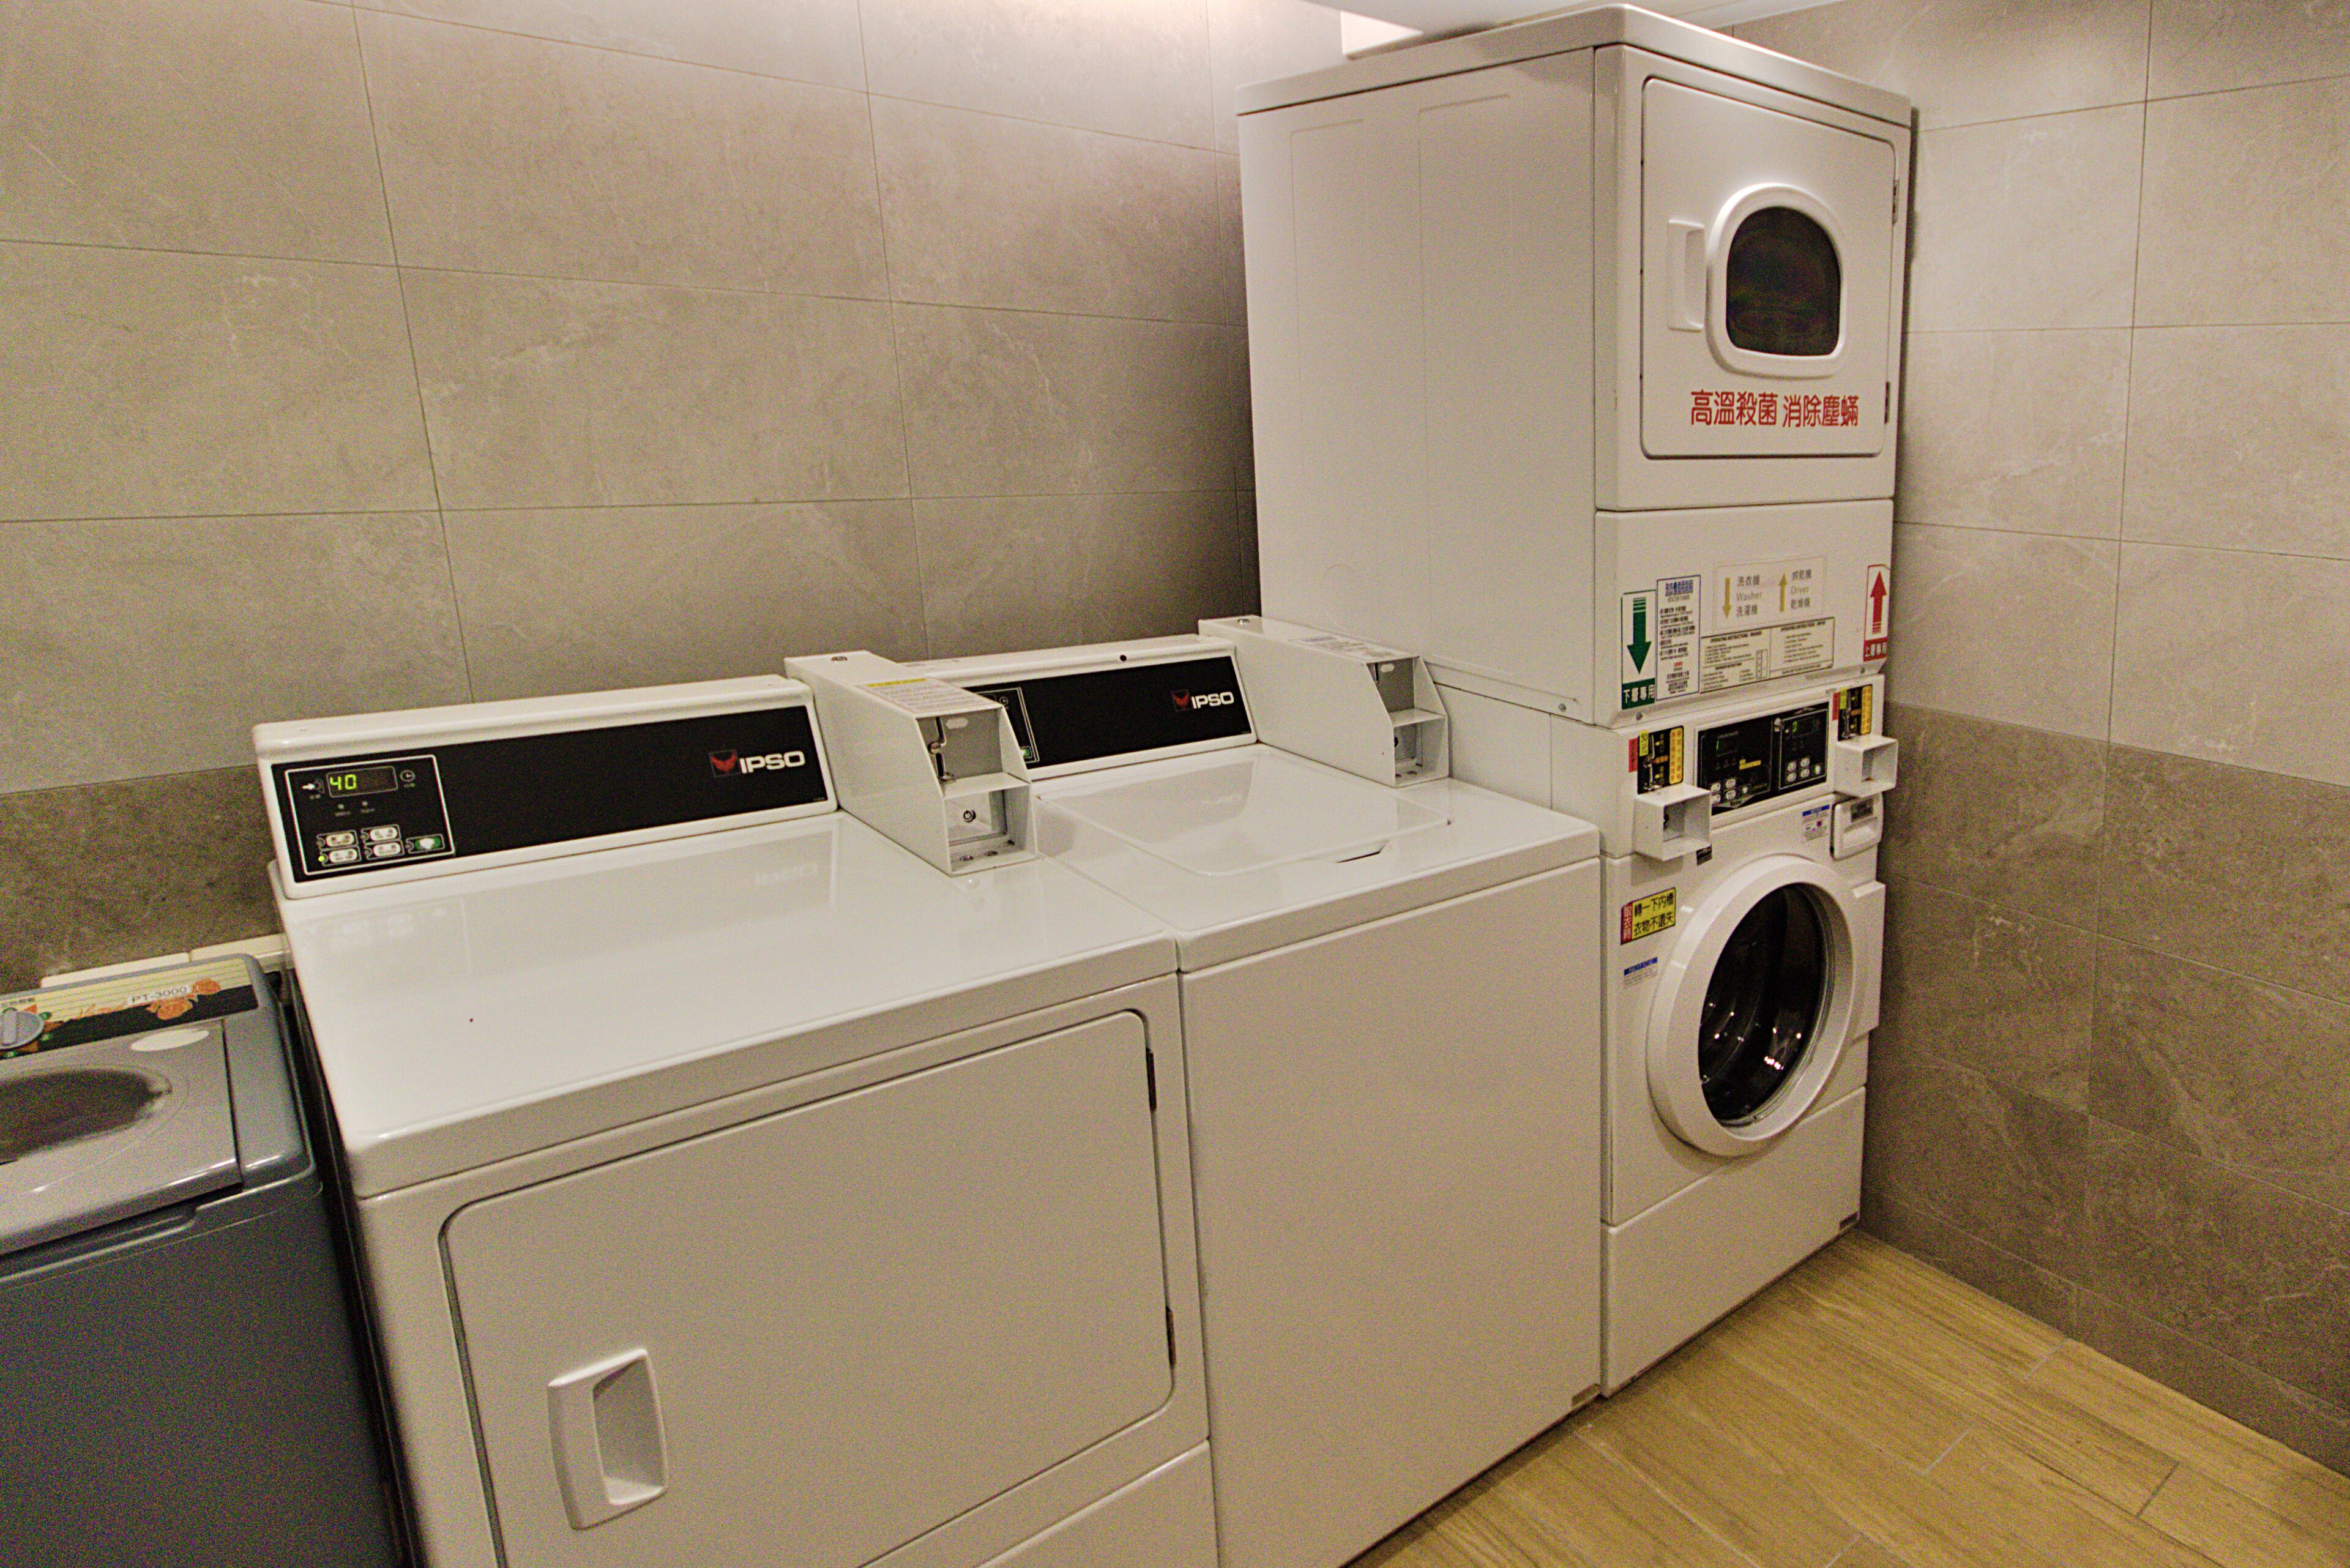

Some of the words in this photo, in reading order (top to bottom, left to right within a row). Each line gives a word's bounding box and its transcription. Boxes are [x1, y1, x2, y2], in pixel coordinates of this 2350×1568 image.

[1690, 389, 1778, 425] 高溫殺菌
[1782, 393, 1859, 427] 消除塵蟎
[1736, 591, 1762, 602] Washer
[1192, 691, 1234, 709] IPSO
[739, 750, 805, 774] IPSO
[329, 773, 357, 791] 40
[1633, 911, 1674, 937] 衣物不遺失
[130, 986, 188, 1004] PT-3000
